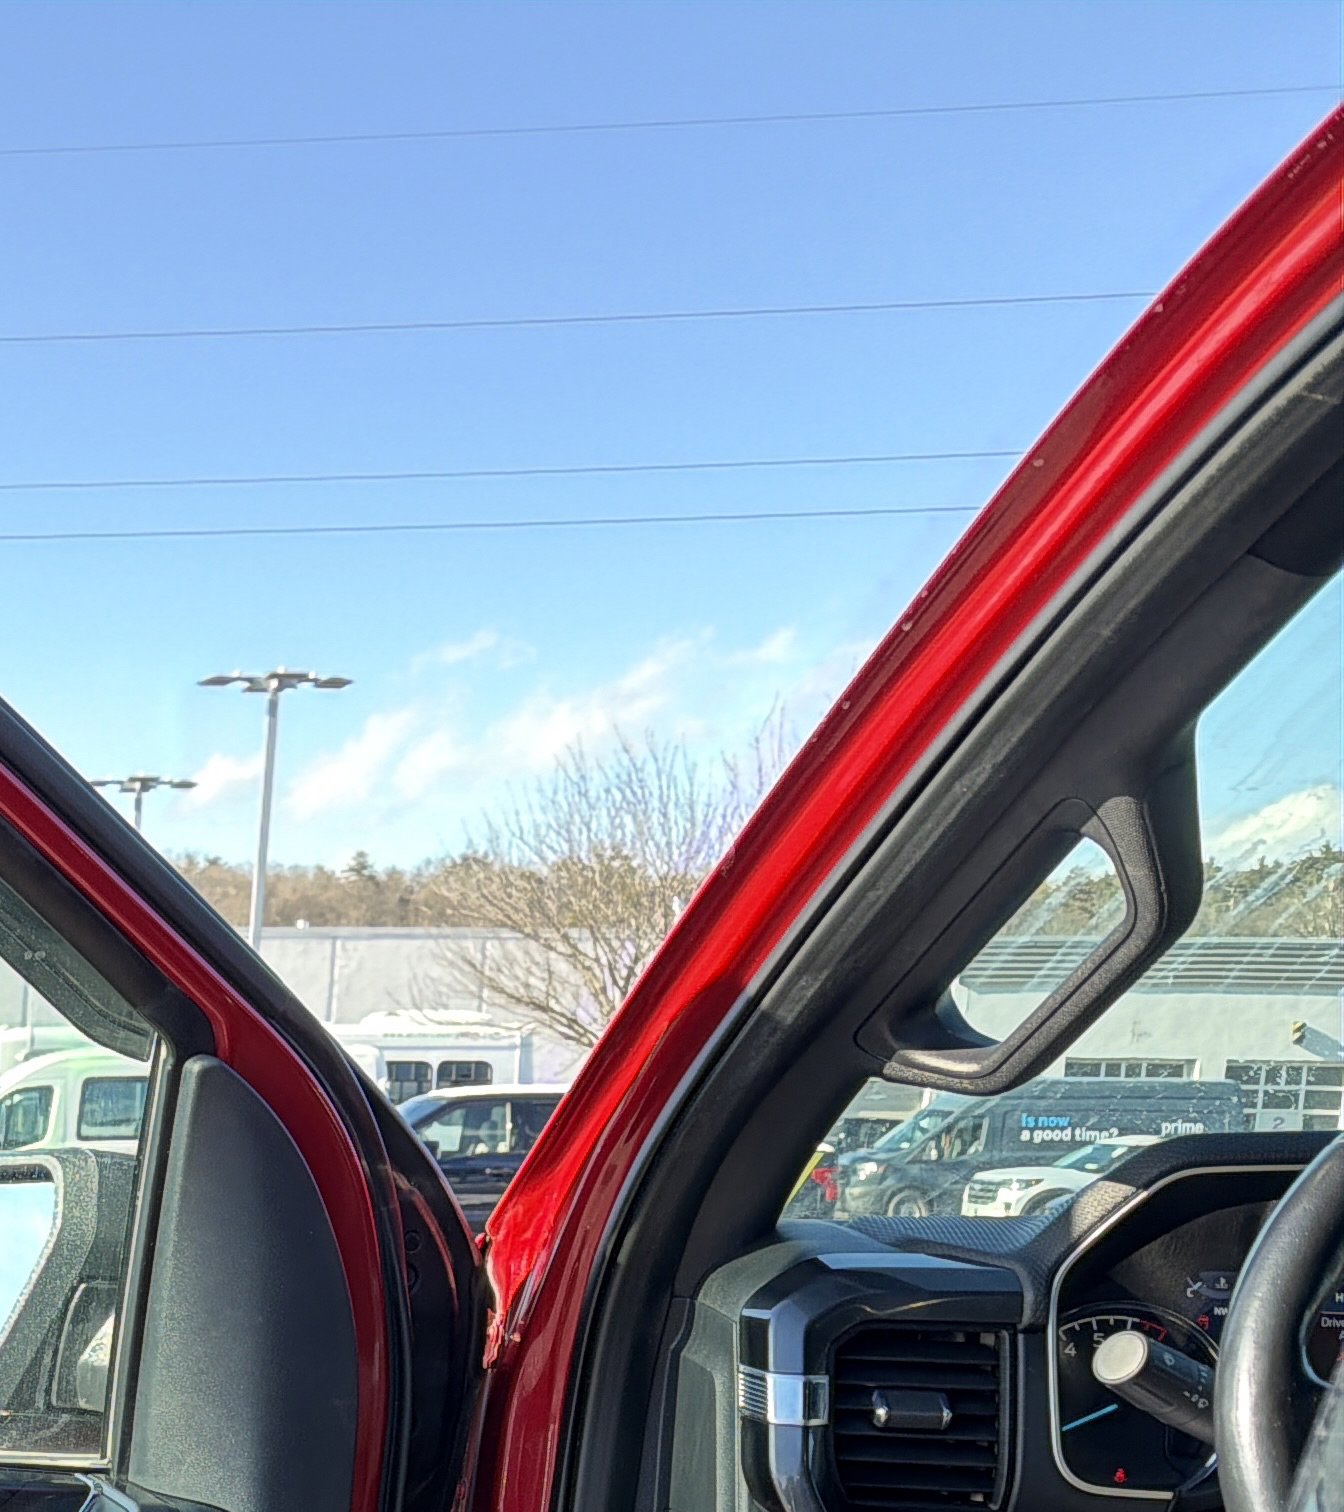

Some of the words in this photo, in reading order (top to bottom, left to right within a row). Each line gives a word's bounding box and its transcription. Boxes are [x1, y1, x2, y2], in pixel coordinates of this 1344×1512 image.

[1038, 1116, 1070, 1127] now
[1161, 1119, 1204, 1137] prime
[1272, 1116, 1285, 1130] 2
[1020, 1129, 1030, 1141] a
[1033, 1127, 1072, 1143] good
[1064, 1342, 1077, 1357] 4
